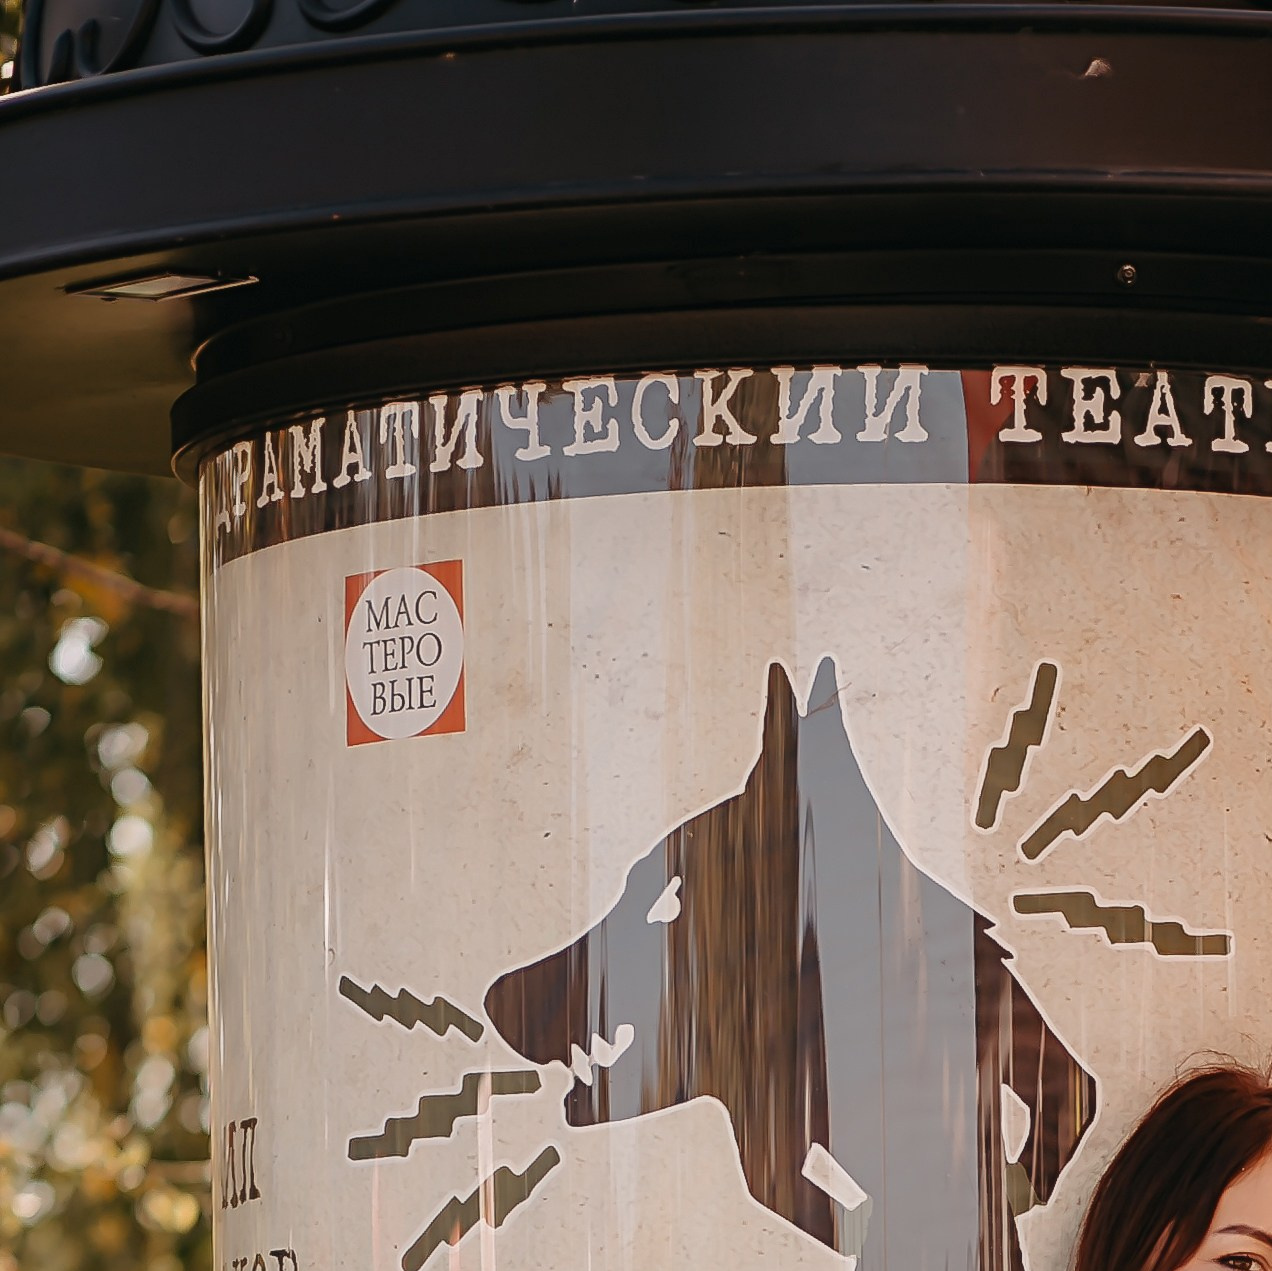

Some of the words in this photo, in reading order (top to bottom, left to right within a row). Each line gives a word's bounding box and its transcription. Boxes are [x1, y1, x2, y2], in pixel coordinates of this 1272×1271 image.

[365, 590, 439, 633] МАС
[362, 632, 443, 675] ТЕРО
[370, 674, 438, 716] ВЫЕ
